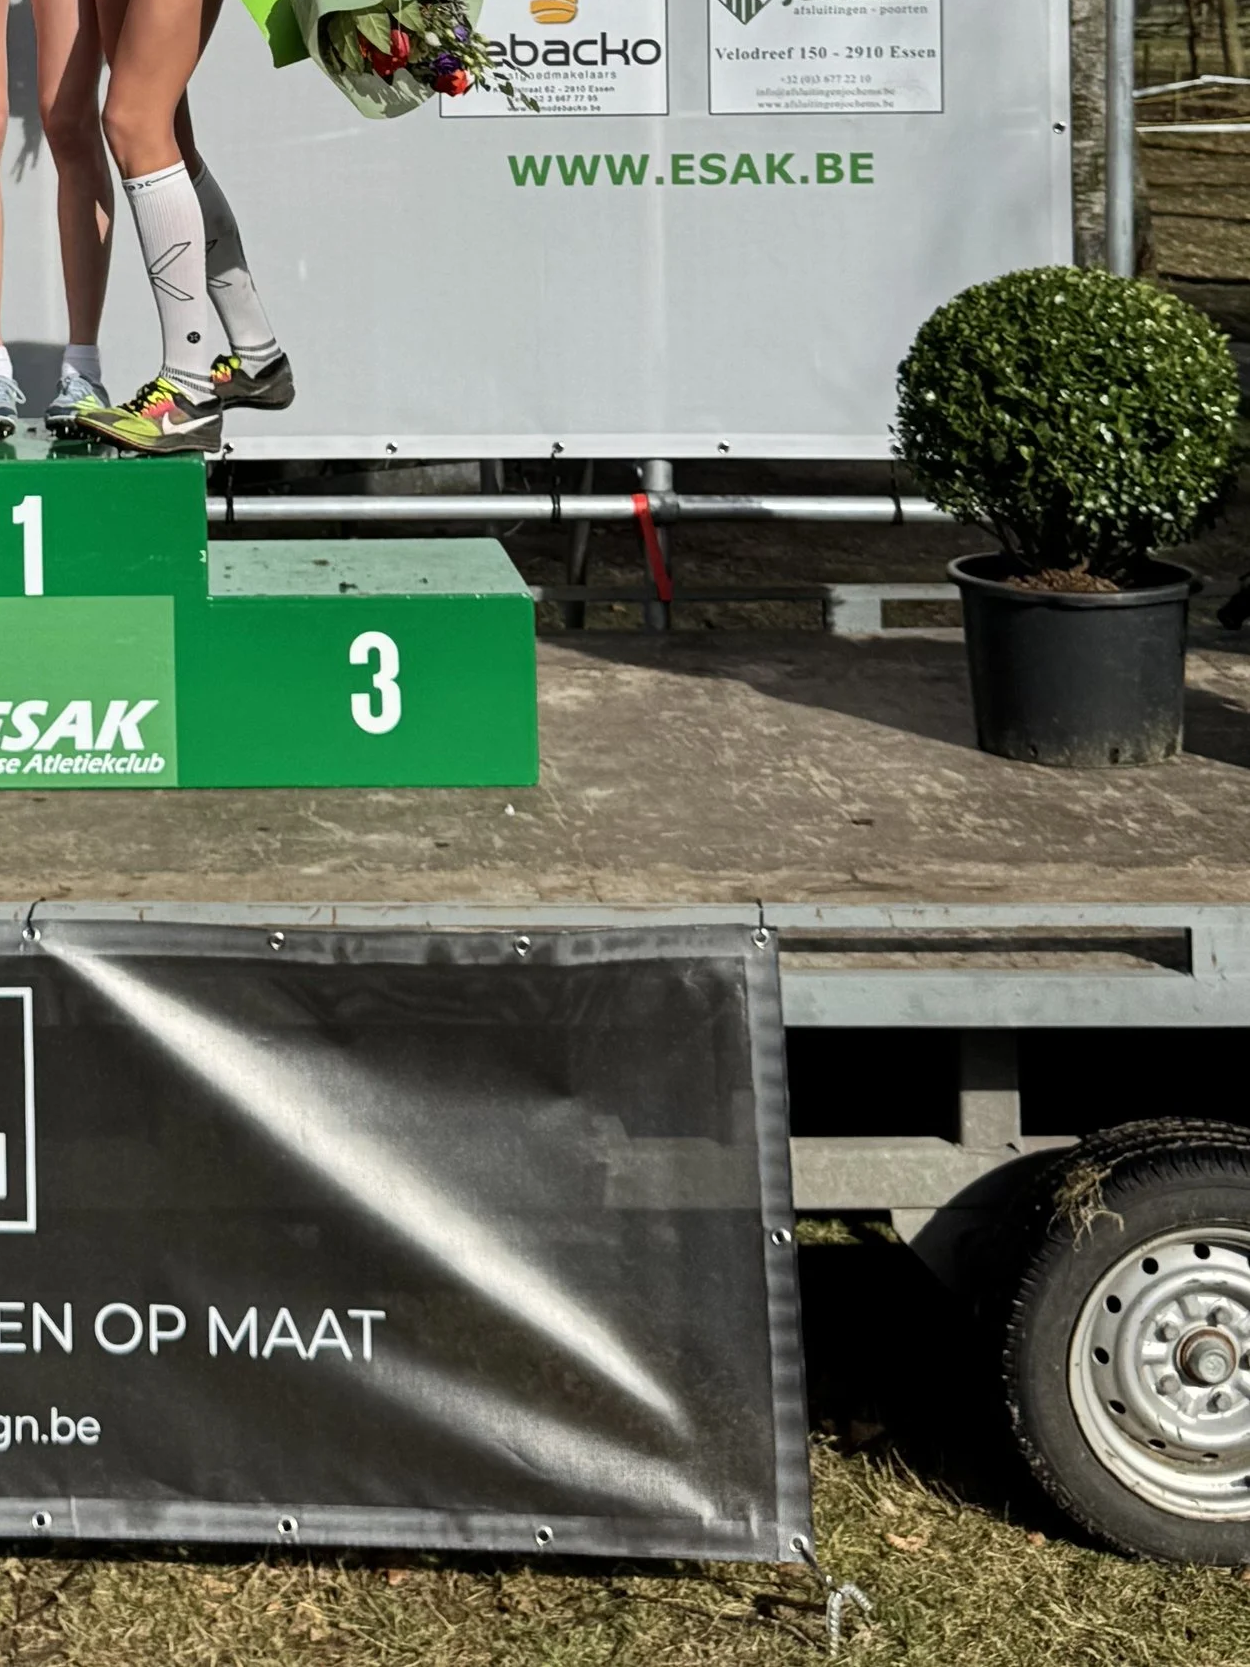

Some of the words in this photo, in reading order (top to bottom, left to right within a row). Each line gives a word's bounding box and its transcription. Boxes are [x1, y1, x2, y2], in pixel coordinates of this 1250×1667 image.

[487, 32, 662, 66] ebacko
[715, 47, 794, 60] Velodreef
[800, 47, 827, 59] 150
[846, 46, 883, 58] 2910
[890, 45, 936, 58] Essen
[507, 152, 874, 186] WWW.ESAK.BE
[11, 495, 45, 597] 1
[349, 630, 402, 735] 3
[23, 753, 165, 774] Atletiekclub
[94, 1302, 187, 1356] OP
[208, 1305, 387, 1361] MAAT
